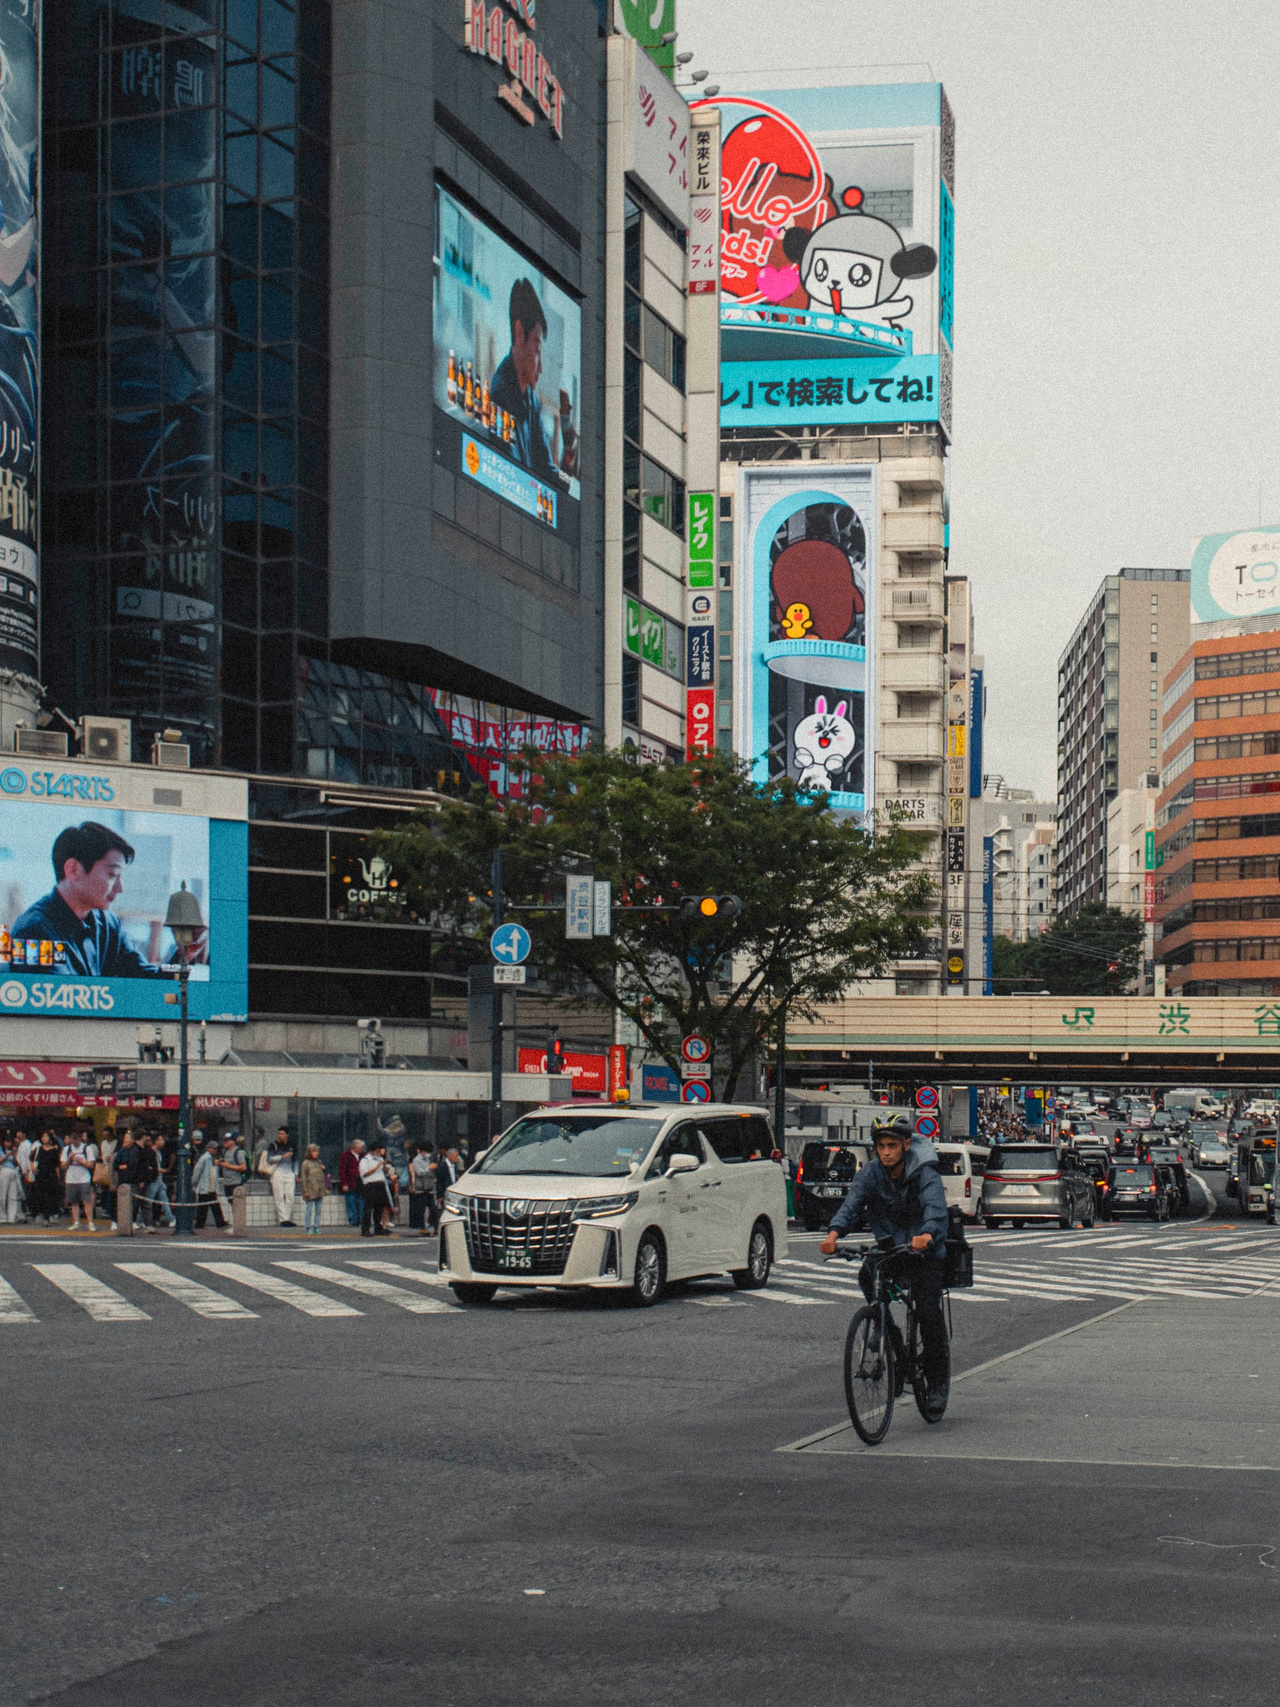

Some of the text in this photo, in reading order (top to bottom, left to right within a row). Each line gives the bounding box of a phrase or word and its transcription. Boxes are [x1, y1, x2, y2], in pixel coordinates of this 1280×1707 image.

[465, 0, 565, 140] MAGNET
[692, 501, 709, 550] レイク
[628, 607, 661, 651] レイク
[885, 799, 925, 809] DARTS
[949, 875, 964, 886] 3F
[578, 882, 589, 934] 渋谷駅前
[1062, 1007, 1096, 1026] JR
[505, 1256, 532, 1268] 19-65
